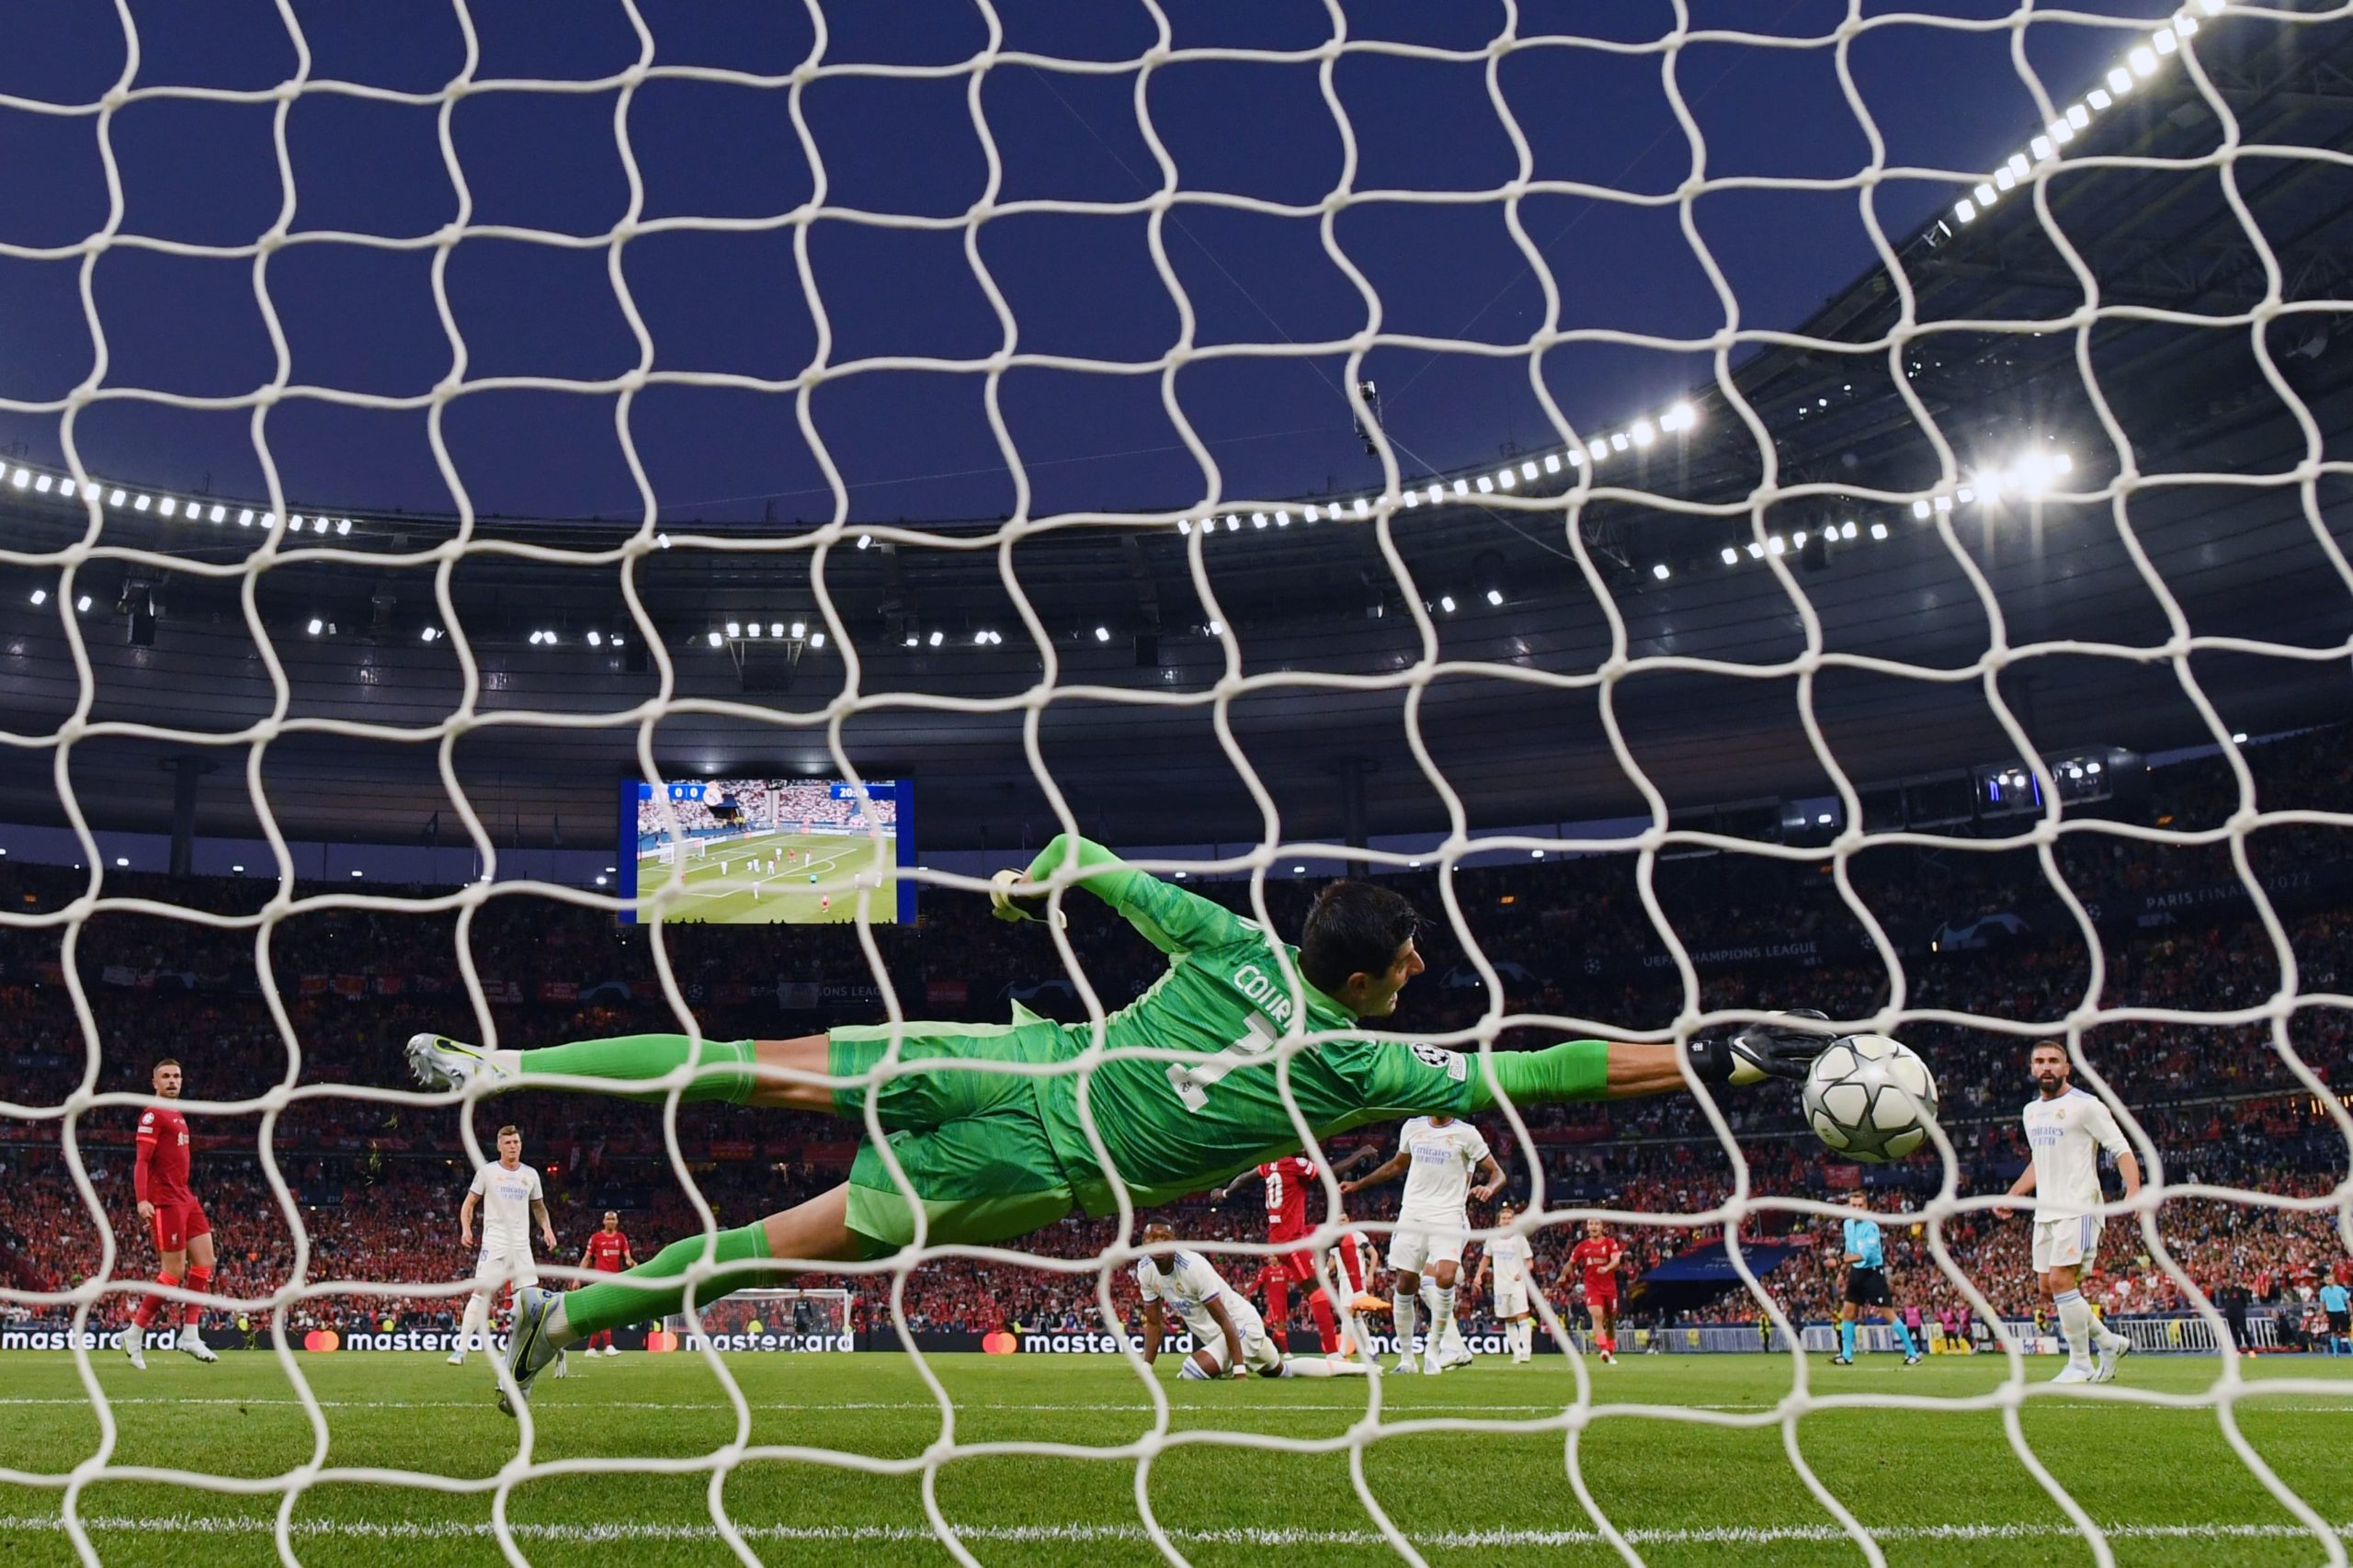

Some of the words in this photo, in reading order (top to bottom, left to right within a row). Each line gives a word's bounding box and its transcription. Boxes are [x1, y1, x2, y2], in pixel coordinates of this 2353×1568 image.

[675, 788, 683, 798] 0
[690, 788, 698, 798] 0
[2146, 892, 2193, 909] PARIS
[2269, 874, 2311, 891] 2022
[1688, 947, 1761, 964] HAMPIONS
[1766, 941, 1817, 958] LEAGUE
[851, 986, 882, 997] LEAG
[2029, 1125, 2064, 1137] mirates
[499, 1186, 528, 1195] mirates
[2, 1328, 176, 1350] mastercrd
[686, 1332, 854, 1352] mastercard
[1025, 1332, 1193, 1354] mastecrd
